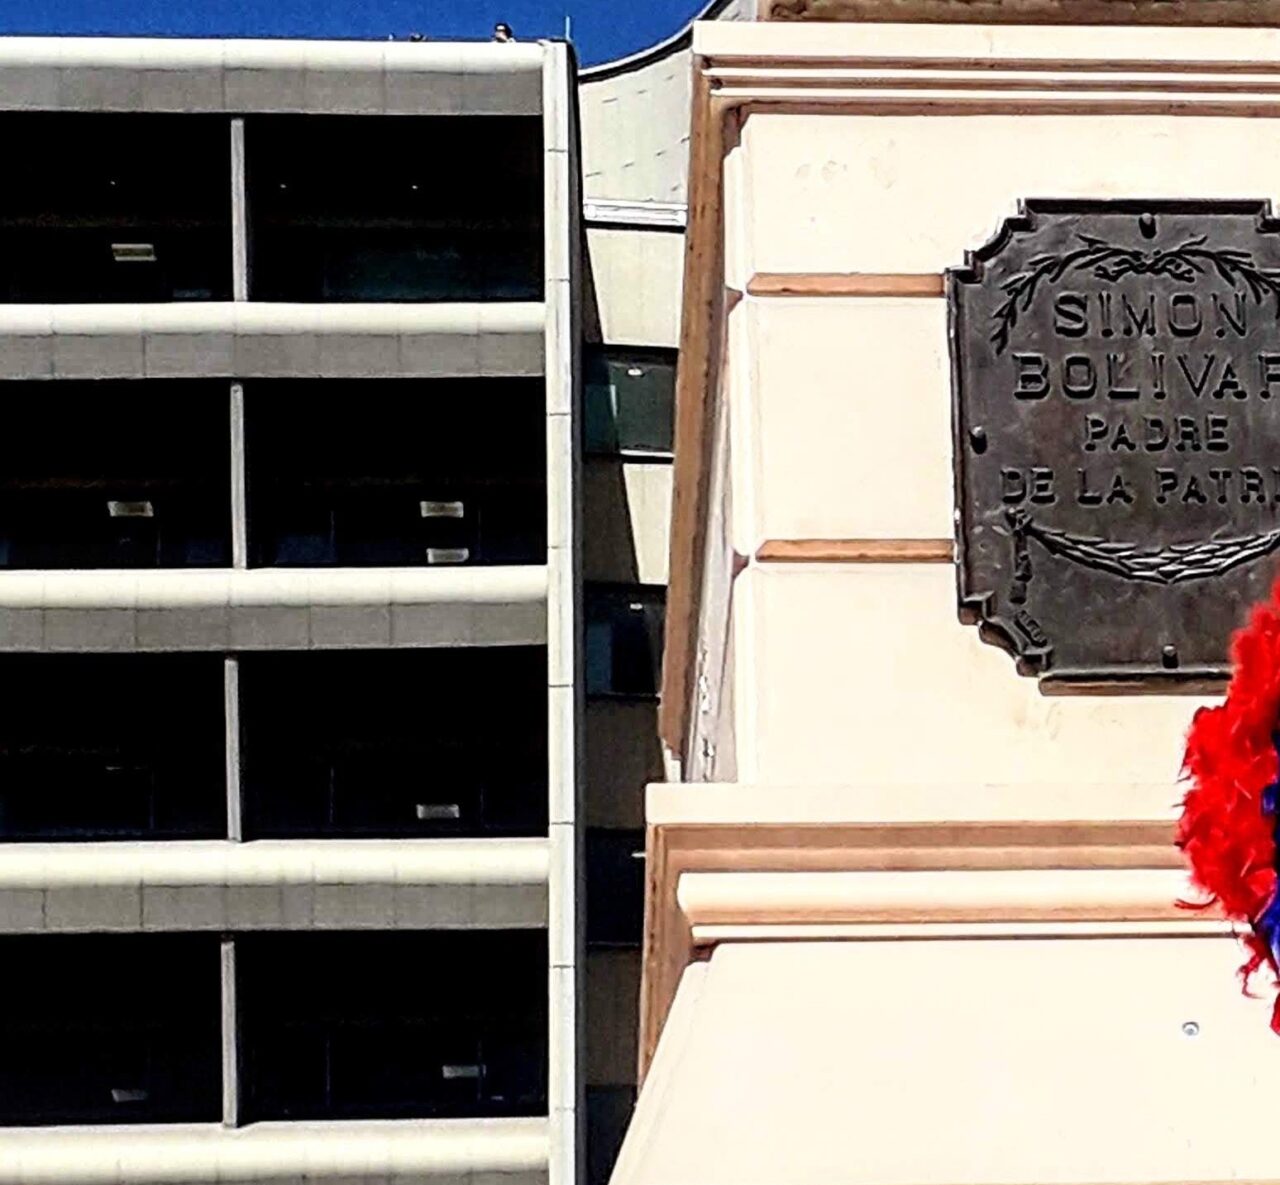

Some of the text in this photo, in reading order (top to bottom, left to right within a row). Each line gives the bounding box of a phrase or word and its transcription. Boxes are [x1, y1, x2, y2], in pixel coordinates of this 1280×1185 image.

[1053, 290, 1248, 339] SIMON
[1083, 413, 1231, 453] PADRE
[1001, 466, 1056, 505] DE
[1076, 467, 1134, 505] LA
